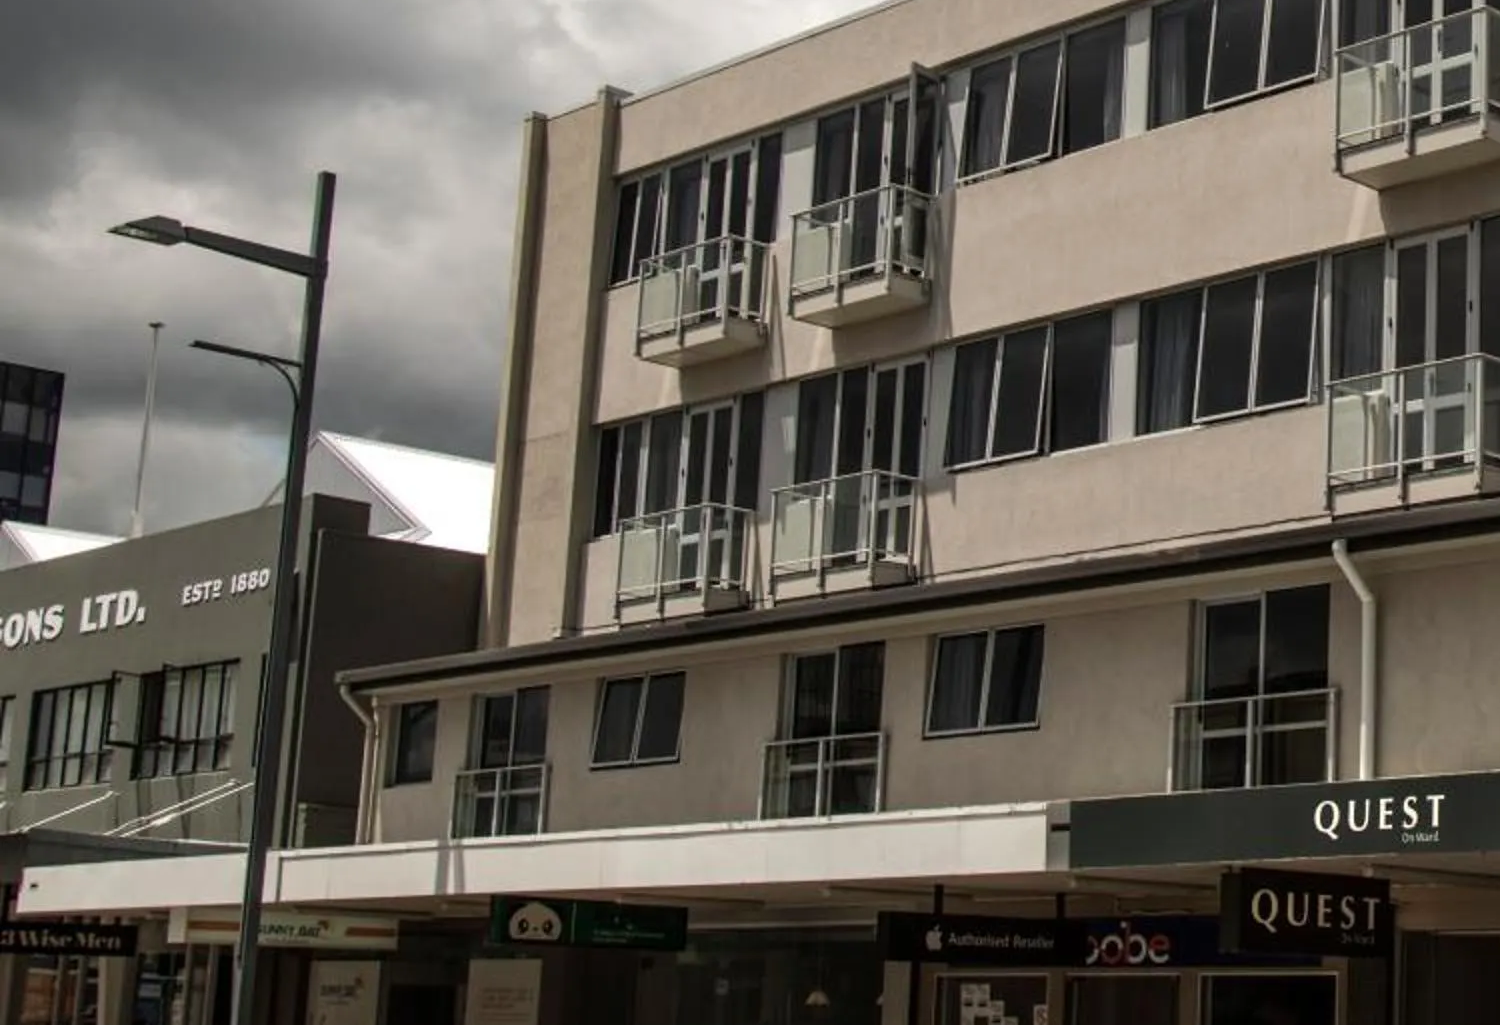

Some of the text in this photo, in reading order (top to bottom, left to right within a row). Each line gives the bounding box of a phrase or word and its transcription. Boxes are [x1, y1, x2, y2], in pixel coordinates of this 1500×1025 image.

[230, 568, 272, 595] 1880
[0, 589, 147, 648] ONS LTD.
[1313, 794, 1446, 841] QUEST
[1250, 888, 1381, 933] QUEST
